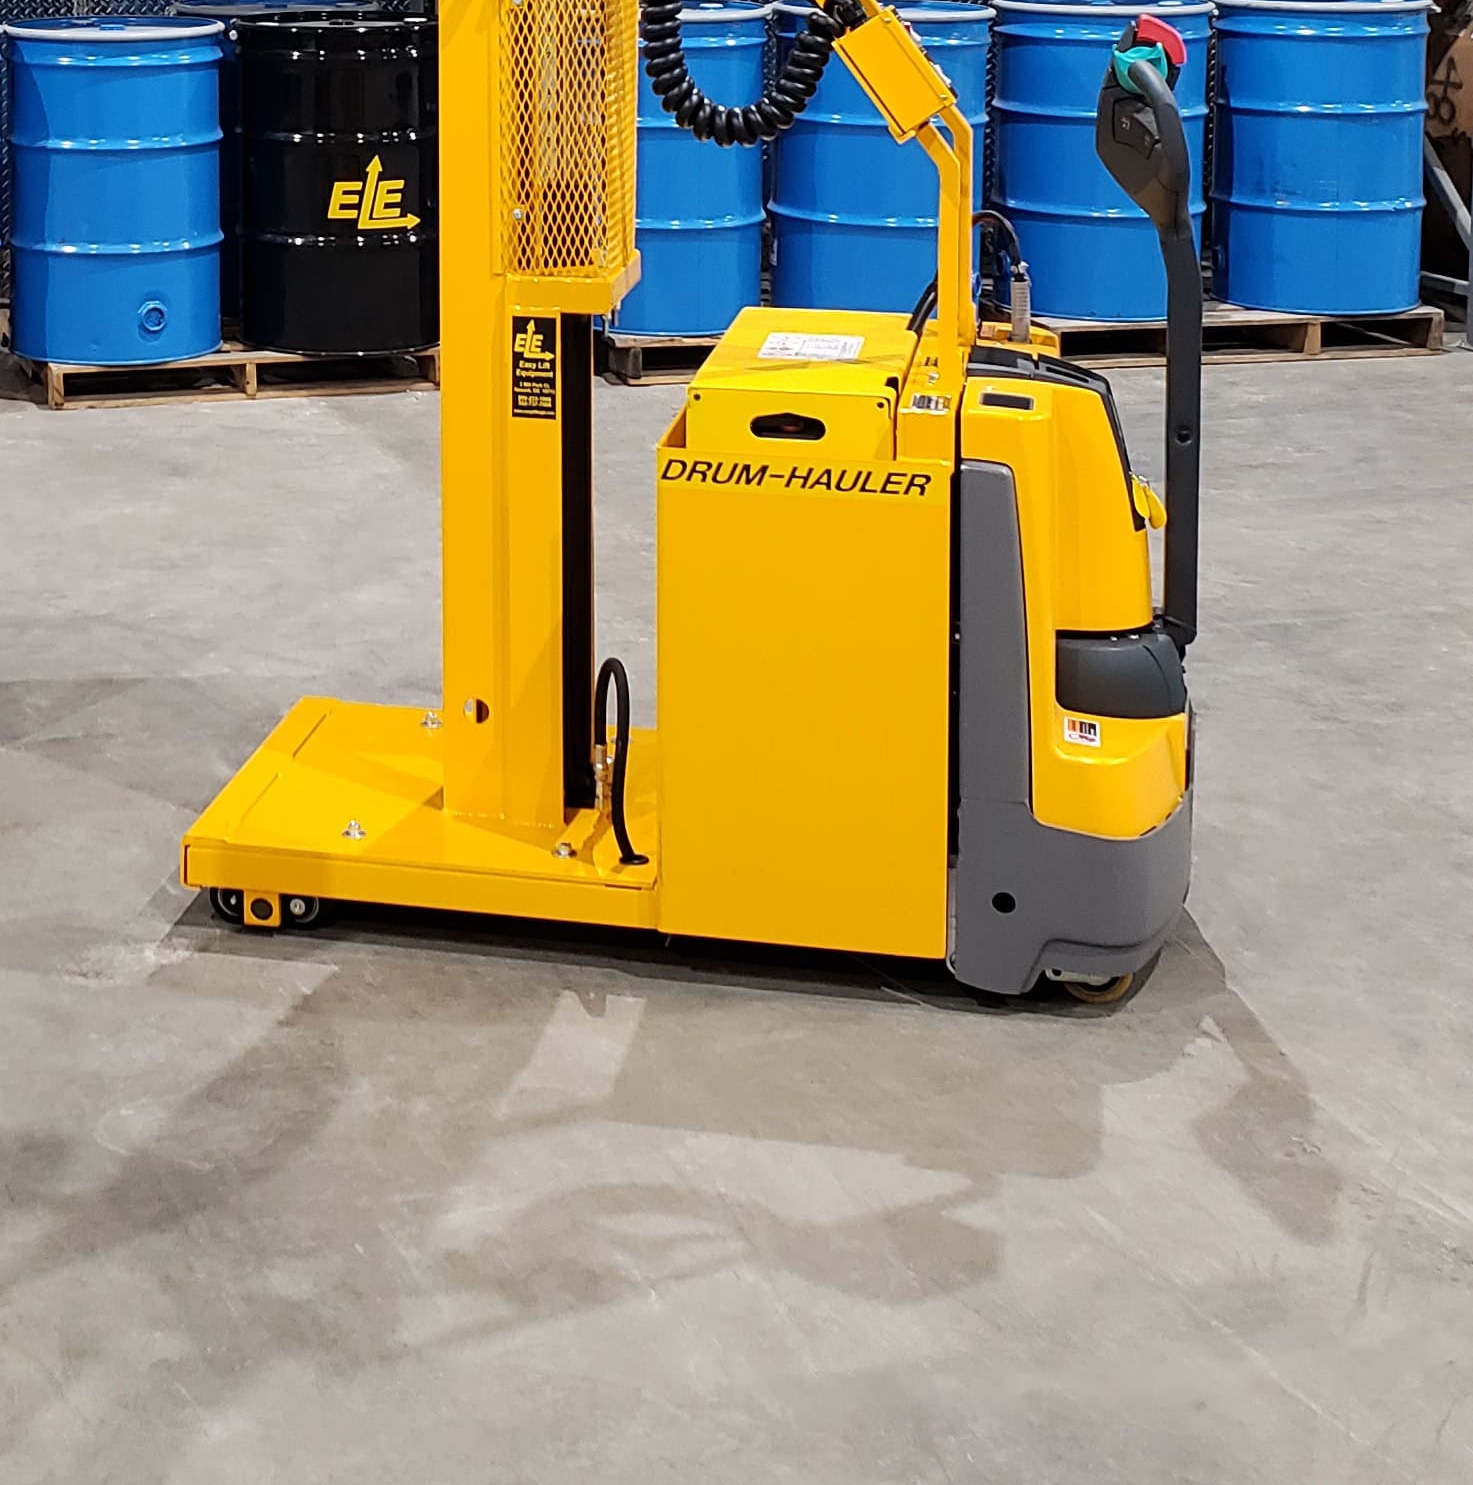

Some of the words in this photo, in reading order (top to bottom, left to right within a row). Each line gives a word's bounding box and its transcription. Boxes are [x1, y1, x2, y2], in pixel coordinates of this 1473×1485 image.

[327, 154, 421, 230] ELE
[514, 319, 555, 360] ELE
[660, 458, 933, 497] DRUM-HAULER
